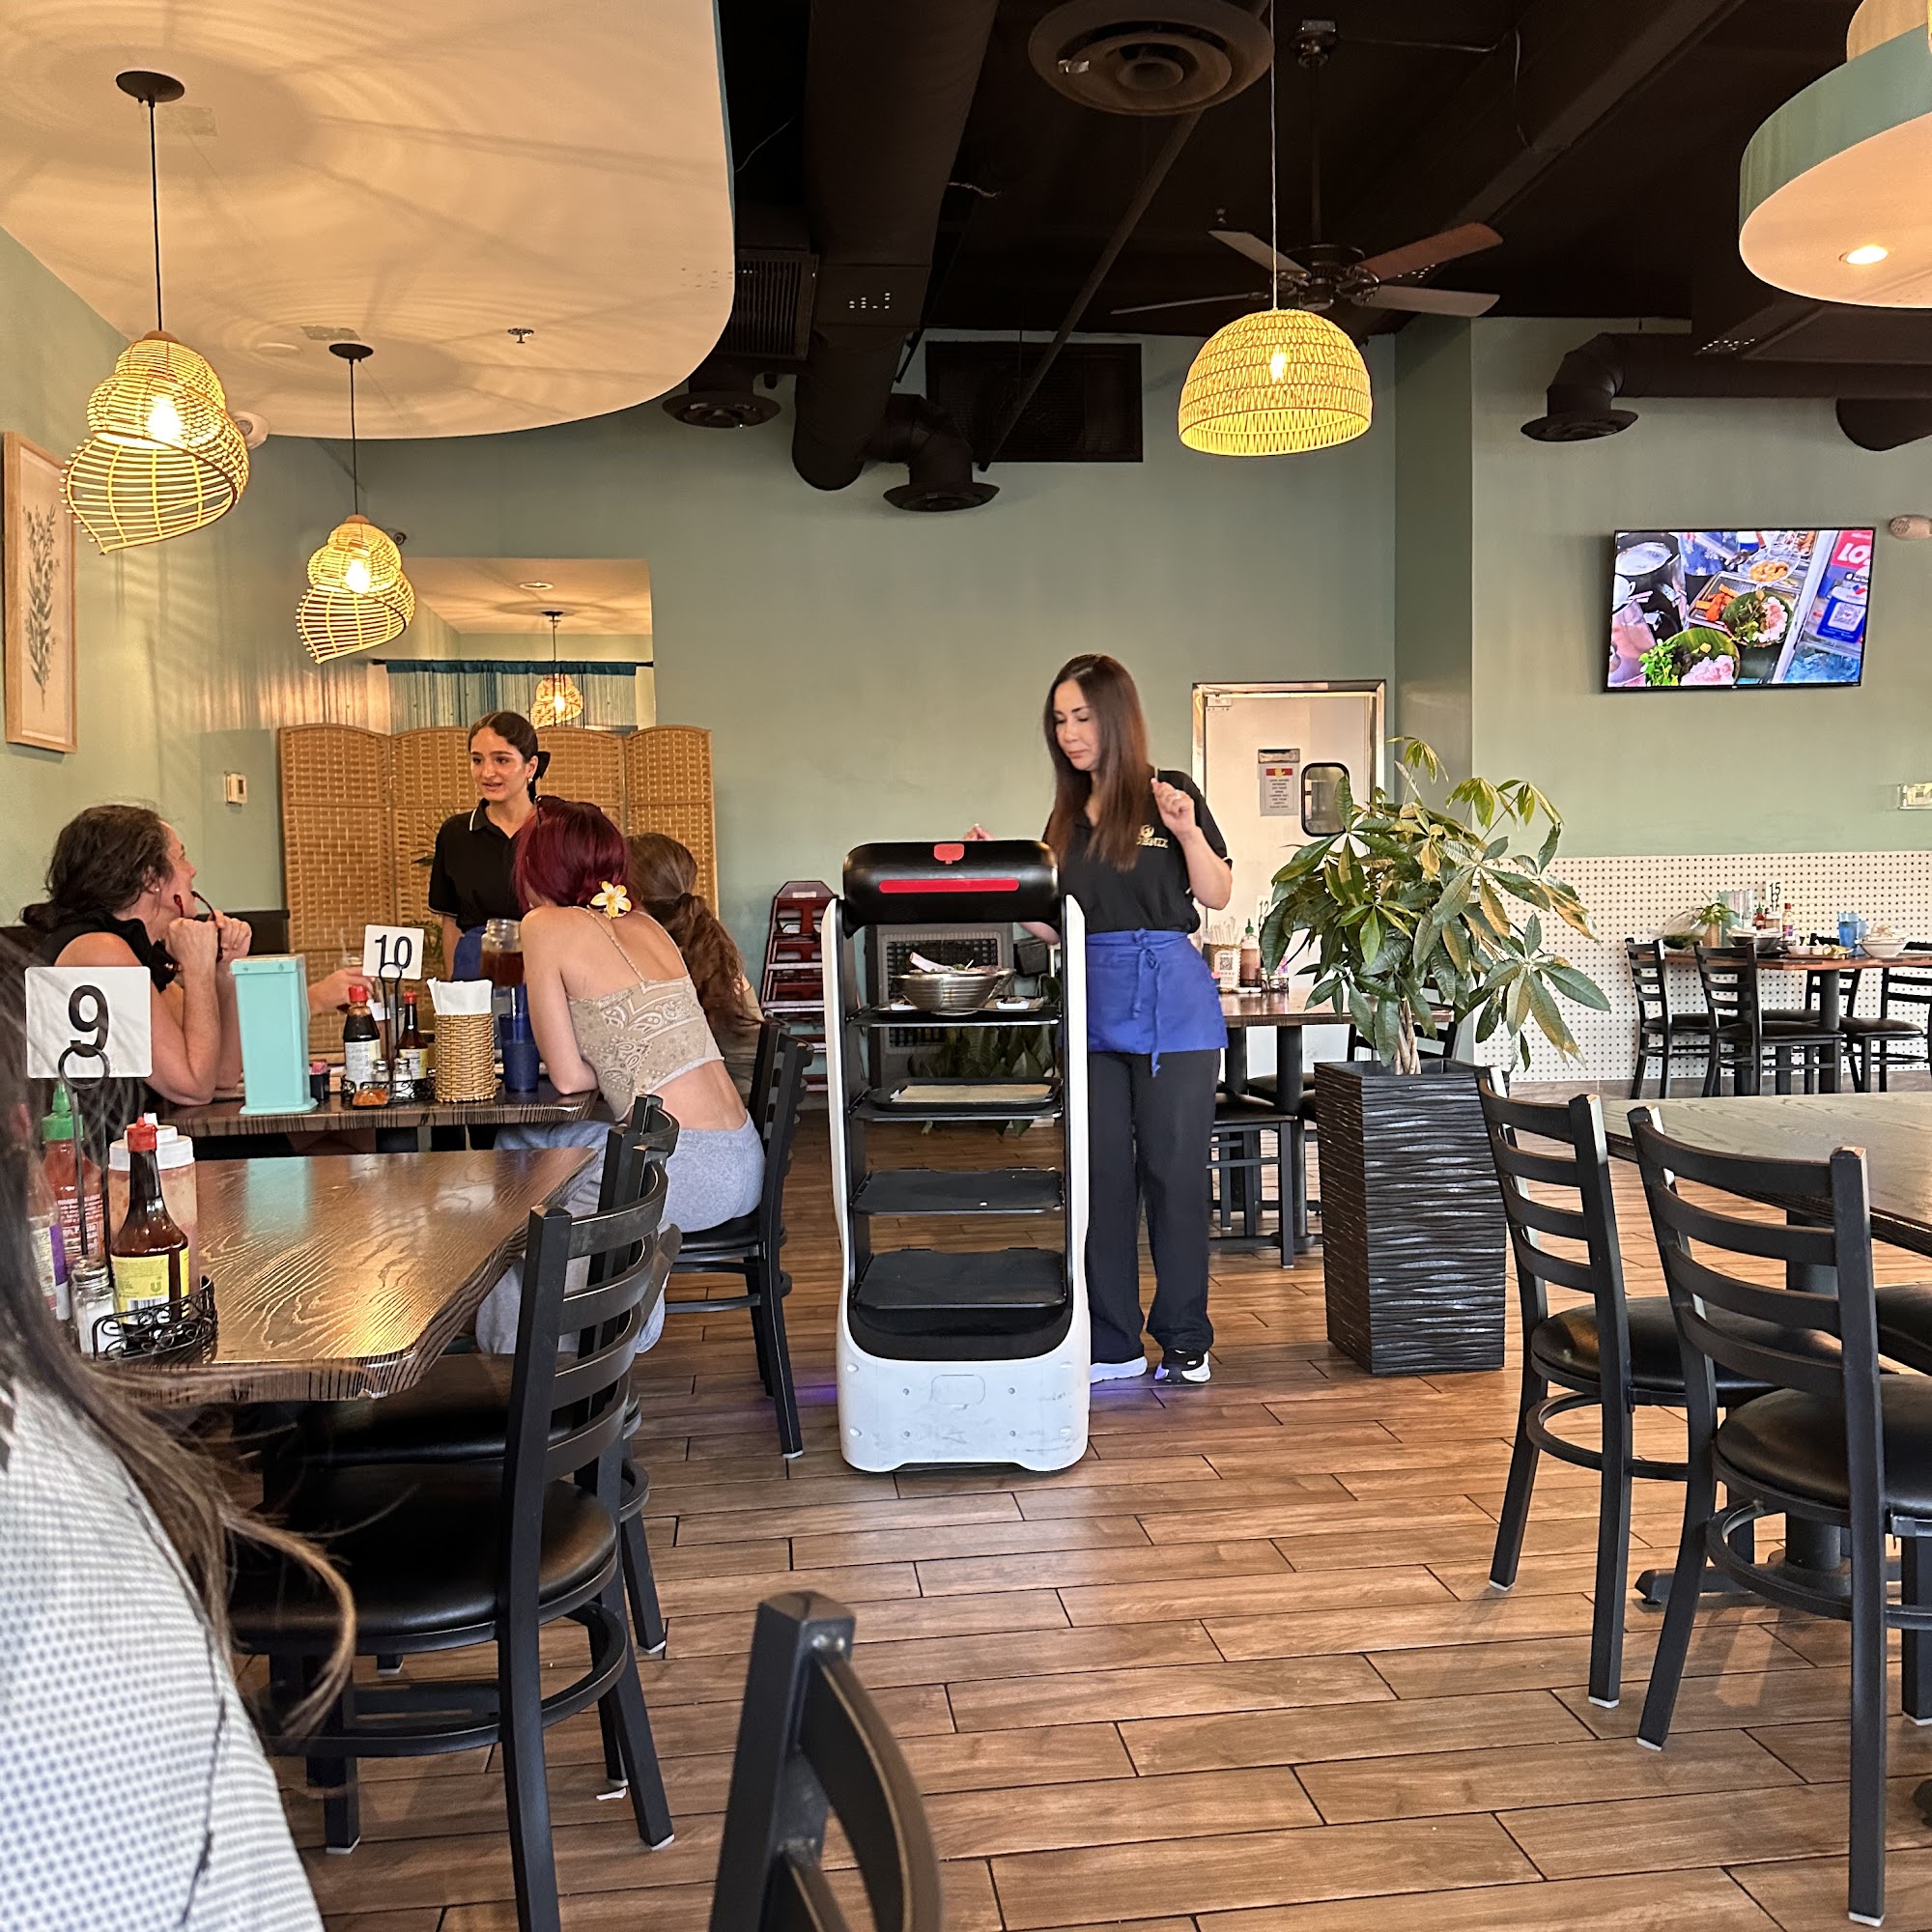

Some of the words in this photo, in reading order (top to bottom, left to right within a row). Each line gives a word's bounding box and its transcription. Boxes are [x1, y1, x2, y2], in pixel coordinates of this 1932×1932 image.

[1769, 882, 1781, 895] 15
[375, 934, 412, 969] 10
[69, 984, 109, 1058] 9
